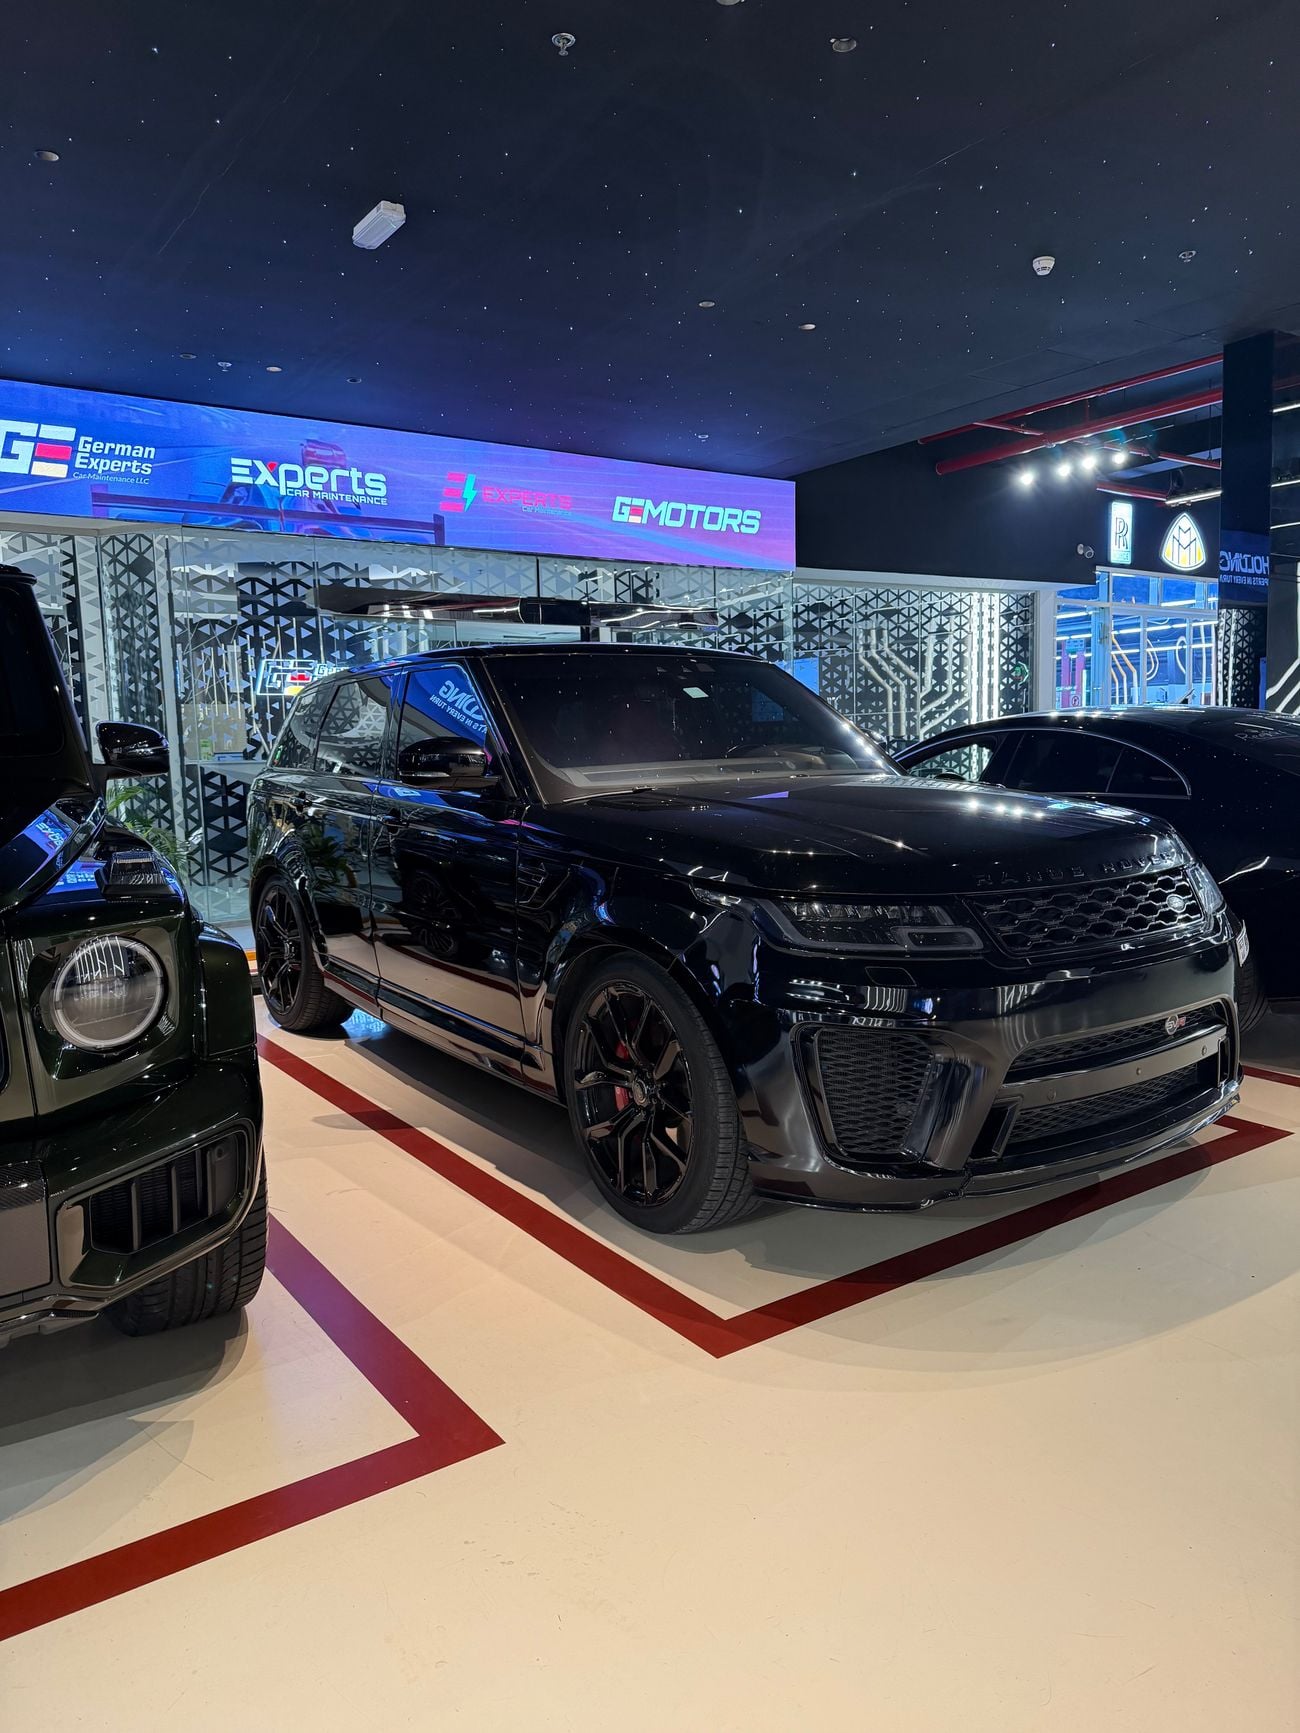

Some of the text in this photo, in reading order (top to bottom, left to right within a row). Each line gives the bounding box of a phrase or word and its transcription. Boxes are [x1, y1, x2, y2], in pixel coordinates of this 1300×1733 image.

[78, 436, 156, 459] German
[74, 452, 152, 475] Experts
[73, 472, 89, 480] Car
[135, 477, 150, 485] LLC
[287, 488, 388, 506] CAR MAINTENANCE
[481, 486, 572, 511] EXPERTS
